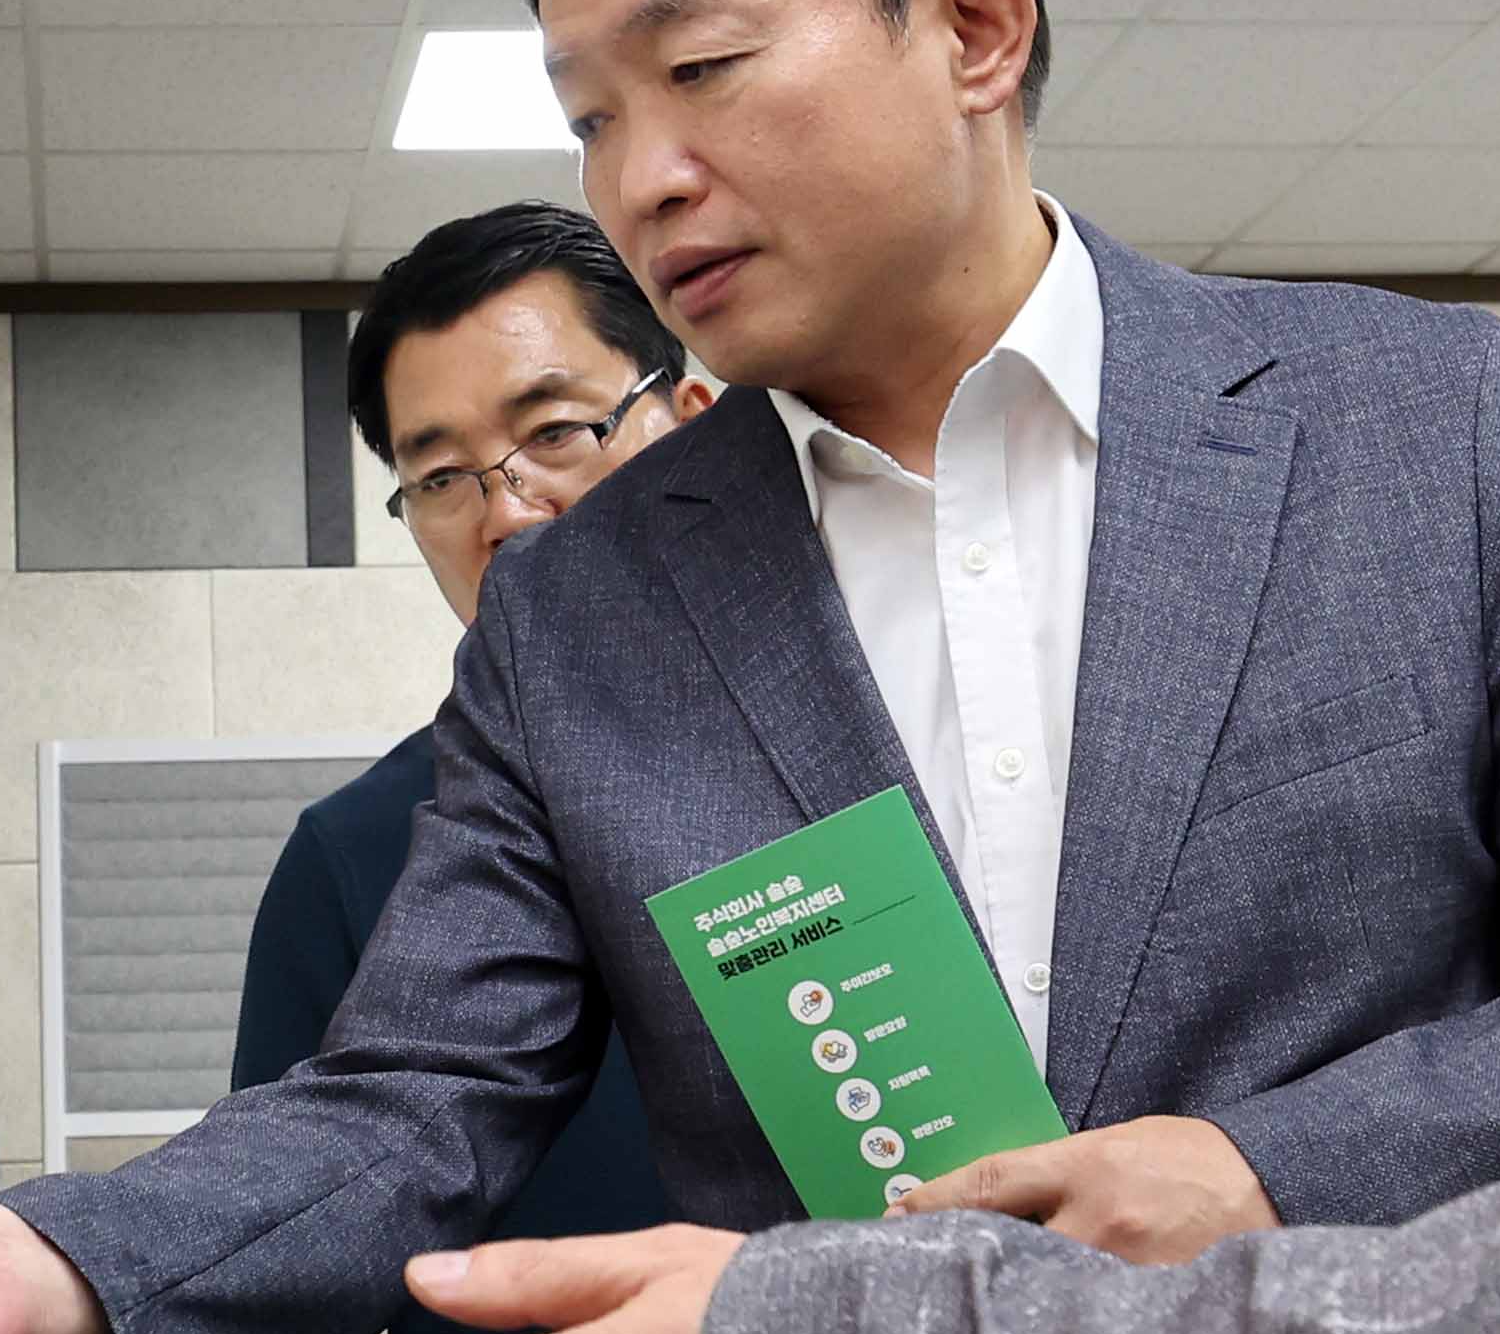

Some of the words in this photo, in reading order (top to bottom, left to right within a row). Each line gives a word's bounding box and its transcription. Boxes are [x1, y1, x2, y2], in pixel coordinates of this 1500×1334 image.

[694, 889, 766, 933] 주식회사
[717, 938, 789, 981] 맞춤관리
[790, 916, 845, 950] 서비스
